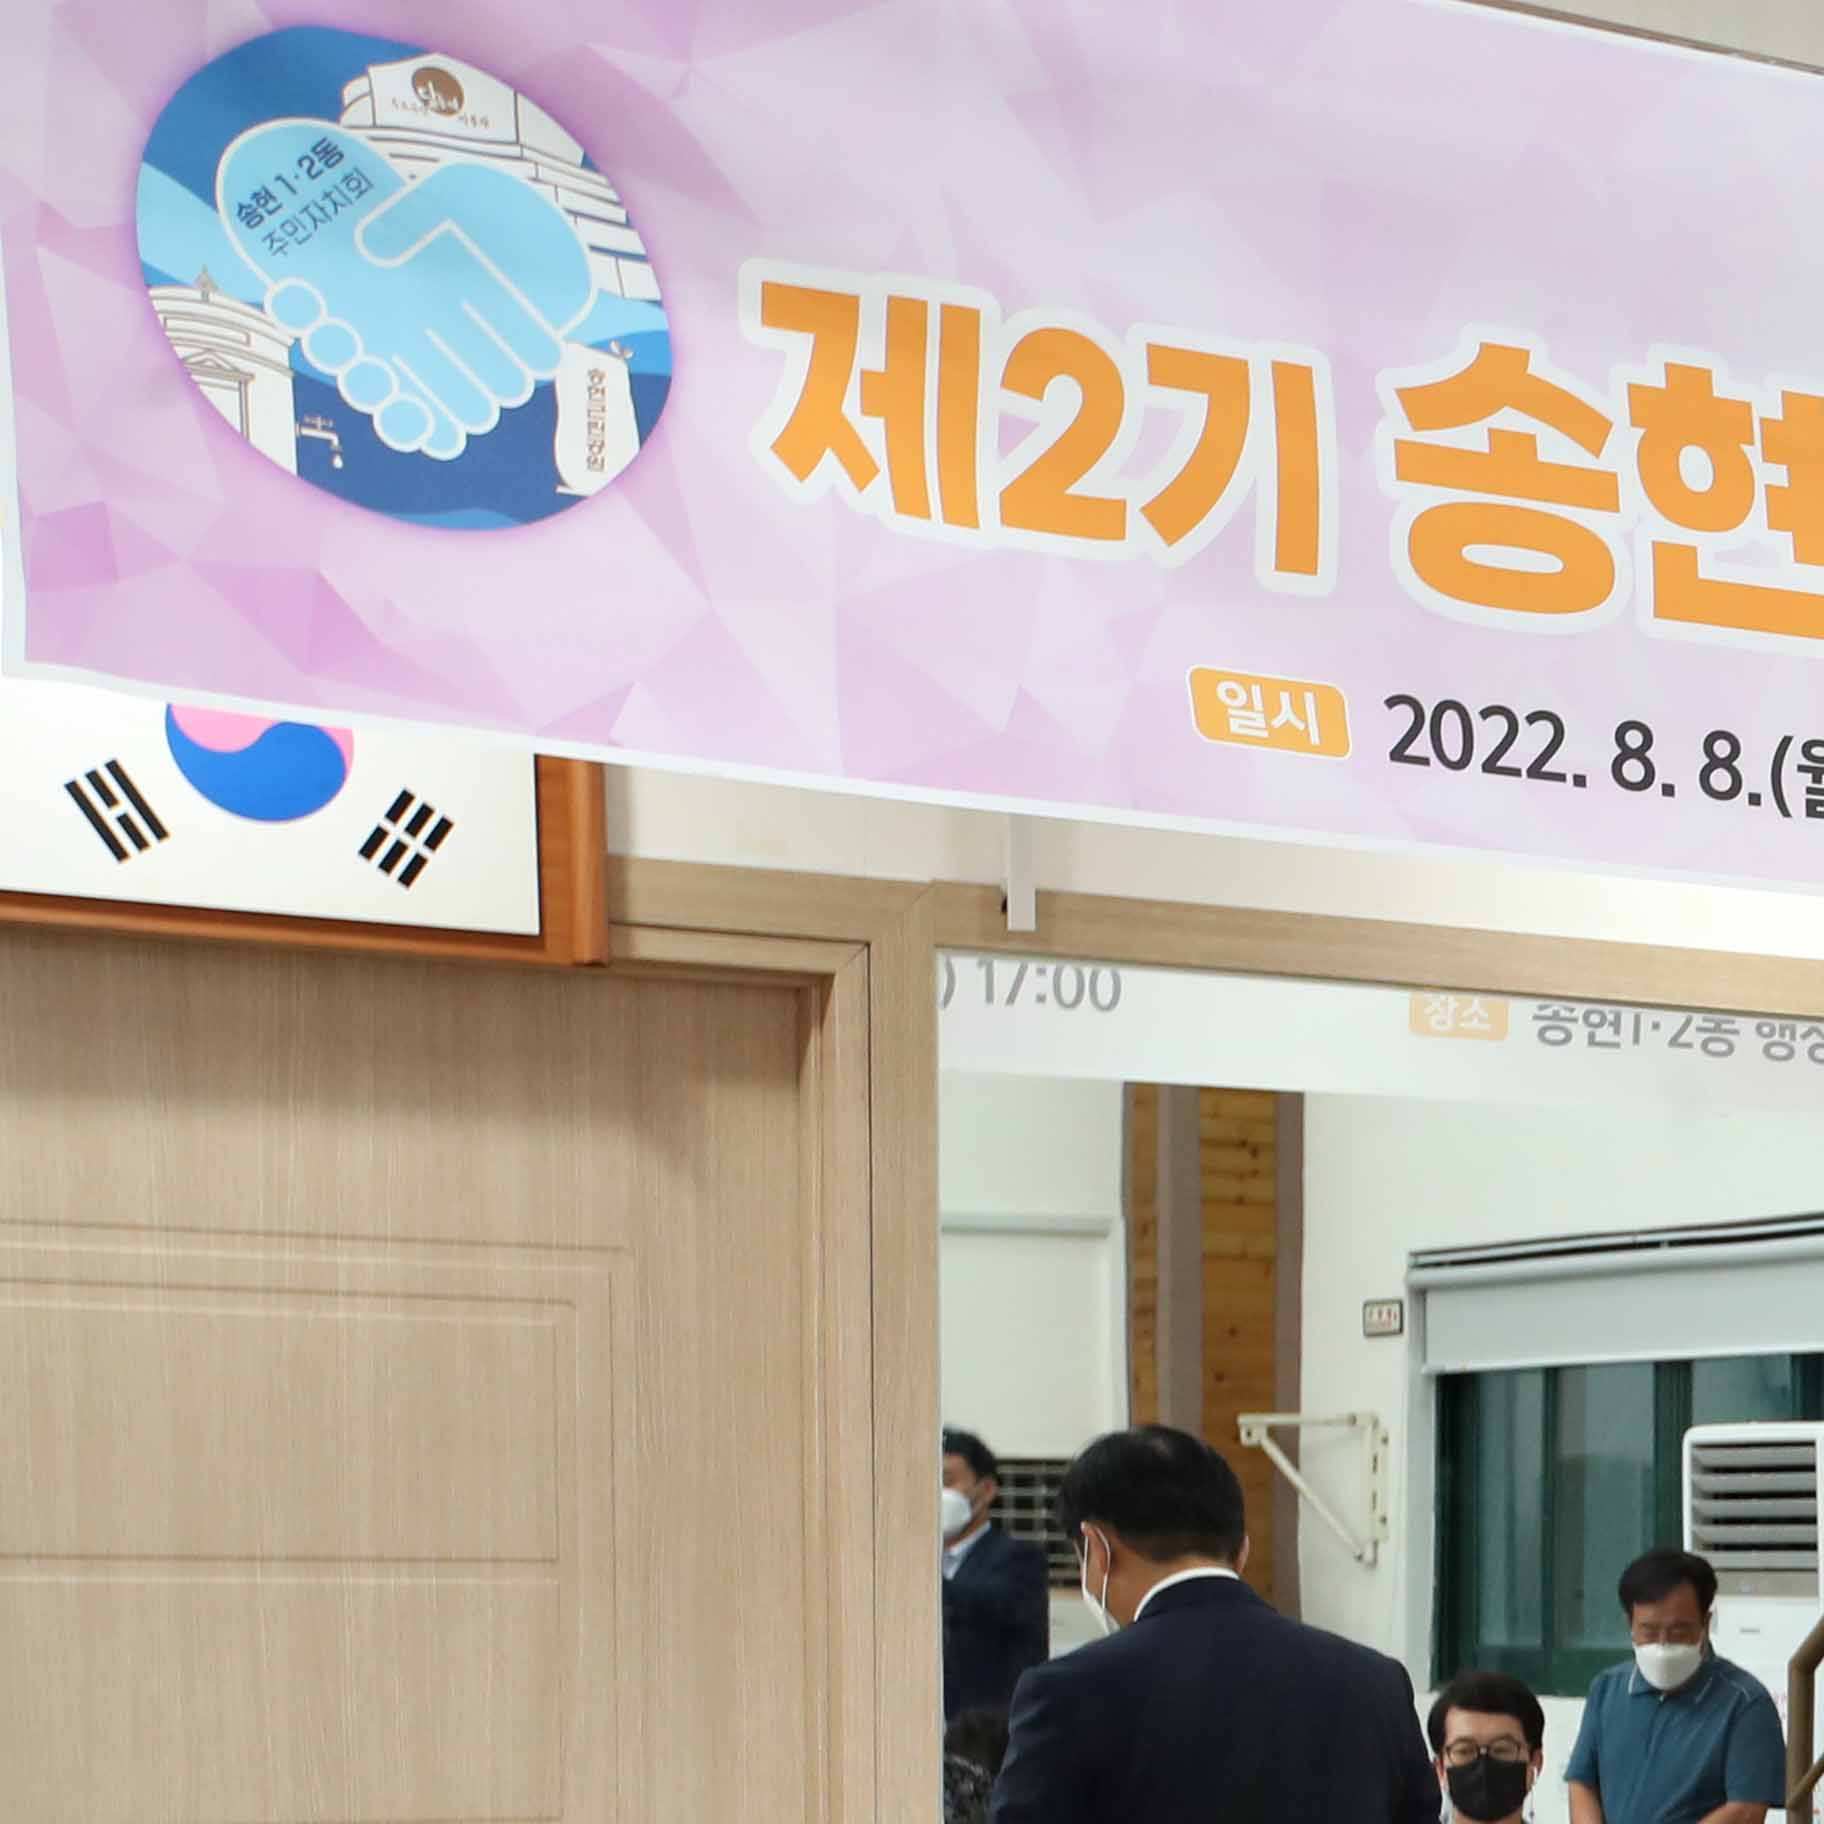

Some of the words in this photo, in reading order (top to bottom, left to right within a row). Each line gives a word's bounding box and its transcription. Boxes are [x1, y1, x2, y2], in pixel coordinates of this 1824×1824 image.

[236, 183, 283, 230] 송현
[261, 166, 375, 257] 주민자치회
[761, 281, 1331, 578] 제2기
[1217, 680, 1321, 745] 일시
[1384, 693, 1588, 789] 2022.
[1610, 719, 1676, 798] 8.
